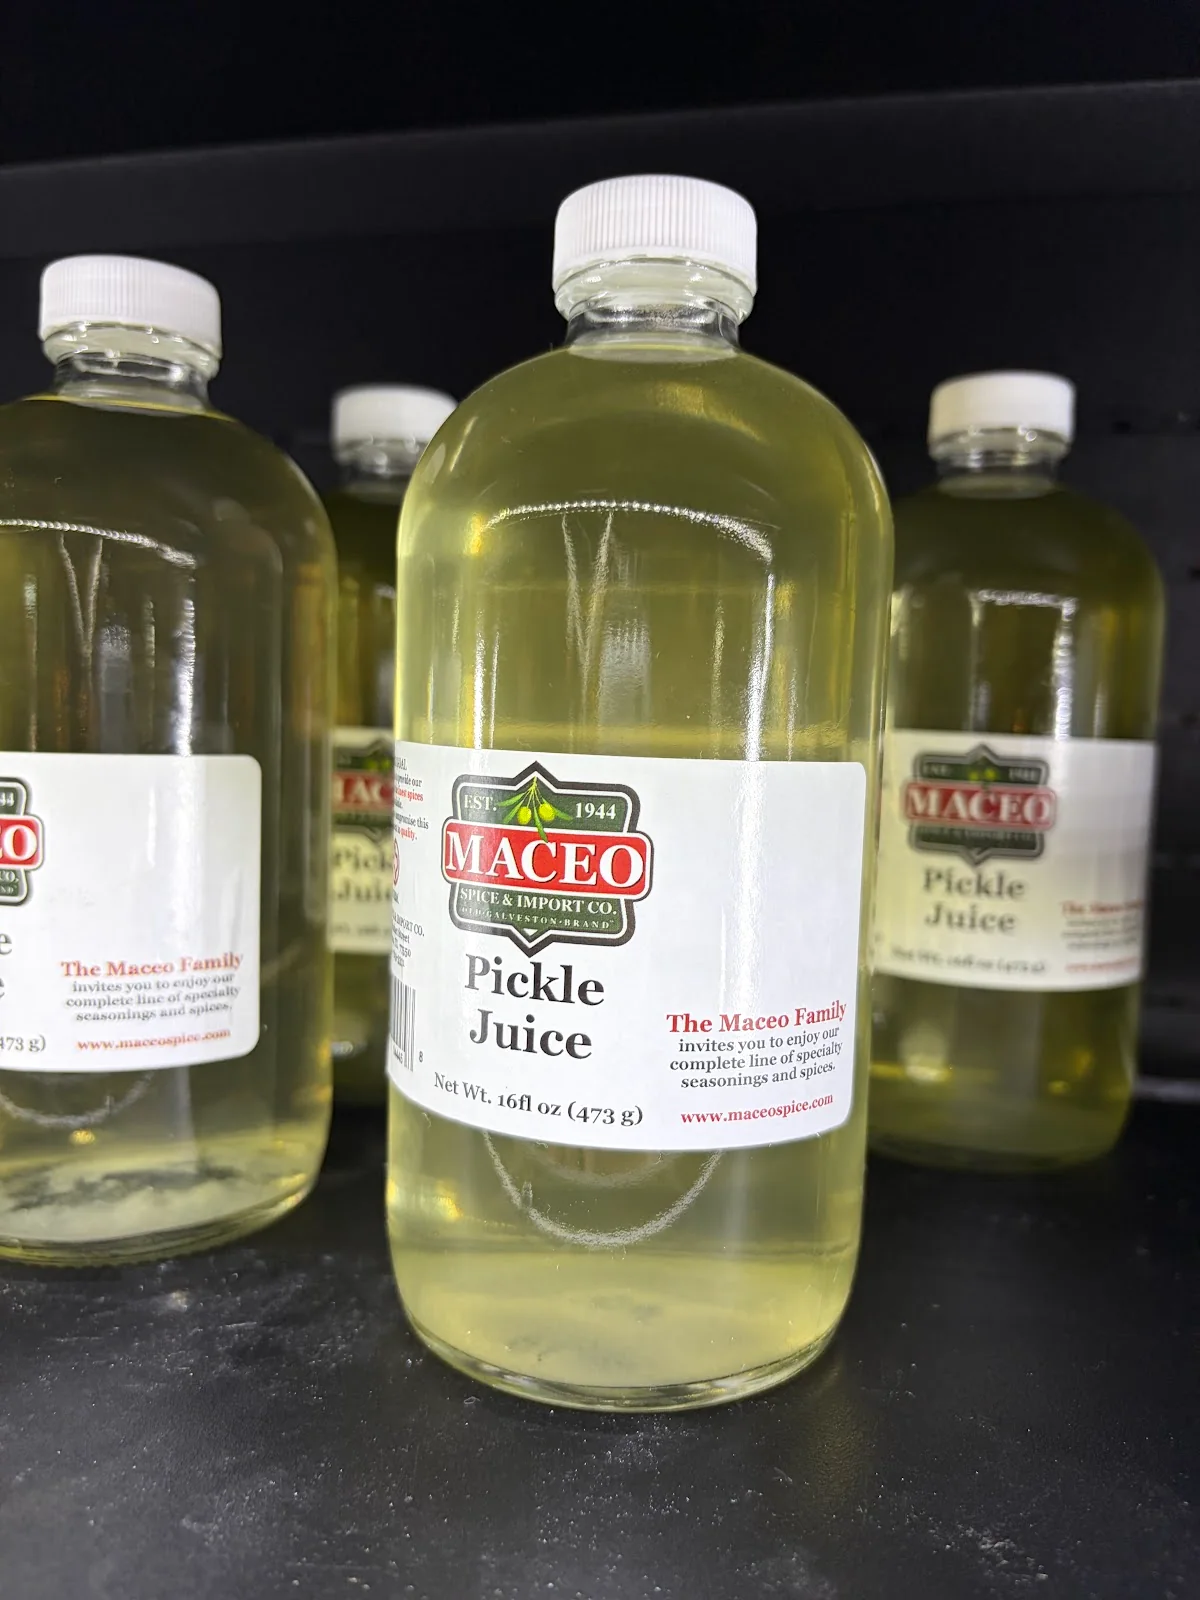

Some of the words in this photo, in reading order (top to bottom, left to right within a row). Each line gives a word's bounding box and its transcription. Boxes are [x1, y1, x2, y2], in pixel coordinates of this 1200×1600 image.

[407, 789, 424, 802] spices
[412, 779, 422, 788] our
[464, 794, 497, 811] EST.
[576, 802, 616, 820] 1944
[907, 788, 1051, 824] MACEO
[417, 817, 429, 830] this
[446, 830, 644, 888] MACEO
[923, 868, 1025, 899] Pickle
[460, 887, 500, 905] SPICE
[502, 894, 513, 906] &
[517, 895, 585, 914] IMPORT
[587, 901, 617, 915] CO.
[925, 903, 1016, 933] Juice
[61, 961, 101, 977] The
[106, 960, 174, 977] Maceo
[180, 952, 243, 973] Family
[72, 980, 122, 993] invites
[125, 980, 152, 993] you
[156, 979, 169, 990] to
[173, 977, 210, 991] enjoy
[212, 974, 235, 985] our
[464, 953, 605, 1006] Pickle
[66, 995, 133, 1008] complete
[168, 991, 181, 1003] of
[184, 986, 240, 1003] specialty
[76, 1009, 156, 1022] seasonings
[160, 1007, 186, 1018] and
[666, 1013, 713, 1033] The
[719, 1013, 789, 1032] Maceo
[794, 1000, 847, 1027] Family
[29, 1035, 46, 1052] g)
[469, 1008, 592, 1060] Juice
[679, 1038, 735, 1053] invites
[738, 1039, 765, 1054] you
[769, 1035, 783, 1048] to
[787, 1030, 820, 1047] enjoy
[822, 1027, 840, 1040] our
[418, 1051, 424, 1063] 8
[670, 1056, 745, 1073] complete
[749, 1053, 777, 1068] line
[780, 1050, 796, 1064] of
[796, 1041, 843, 1064] specialty
[681, 1072, 768, 1088] seasonings
[772, 1067, 797, 1083] and
[800, 1062, 836, 1081] spices.
[434, 1072, 459, 1095] Net
[462, 1081, 492, 1104] Wt.
[498, 1093, 532, 1112] 16fl
[537, 1101, 562, 1117] oz
[567, 1101, 616, 1125] (473
[621, 1105, 643, 1127] g)
[681, 1094, 834, 1124] www.maceospice.com
